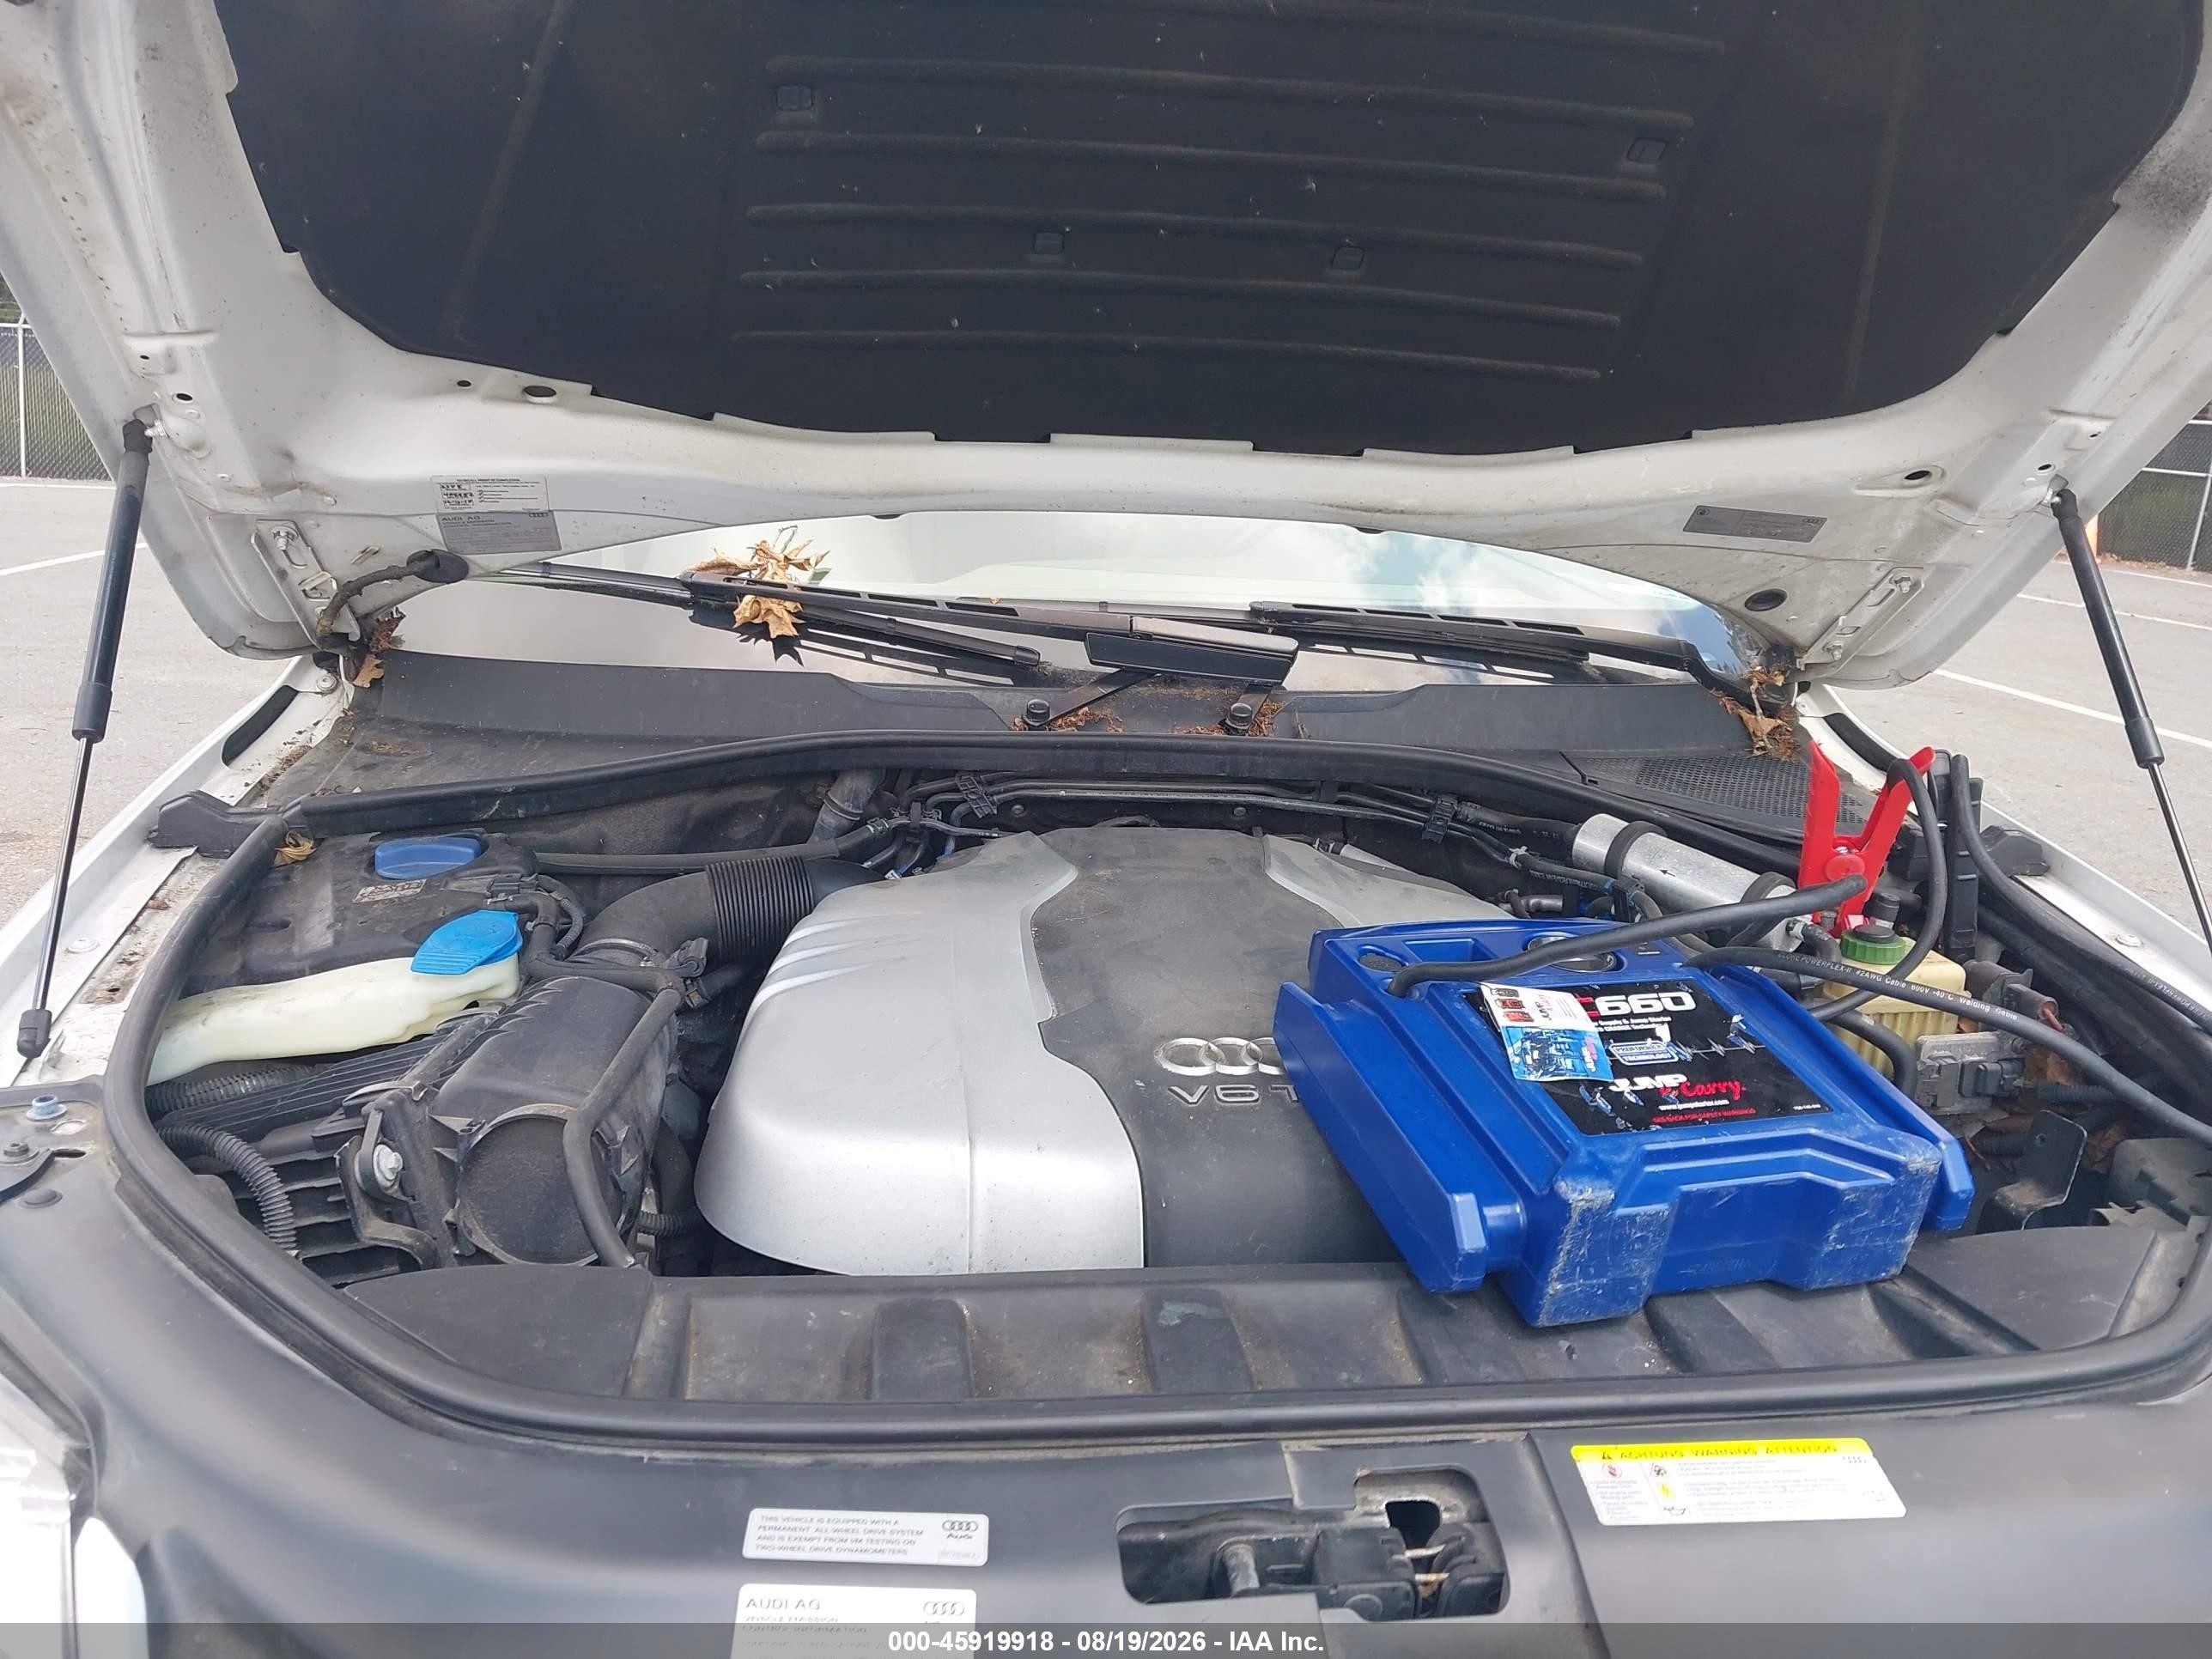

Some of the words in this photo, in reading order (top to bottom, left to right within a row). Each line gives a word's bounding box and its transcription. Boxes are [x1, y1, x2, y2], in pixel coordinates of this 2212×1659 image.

[1856, 969, 1882, 981] #2AWG
[1885, 976, 1906, 988] Cable
[1960, 996, 1990, 1012] Welding
[1168, 1084, 1261, 1107] V6
[1680, 1079, 1741, 1101] Carry
[782, 1516, 814, 1524] VEHICLE
[863, 1527, 887, 1535] DRIVE
[787, 1535, 822, 1544] EXEMPT
[866, 1538, 902, 1547] TESTING
[809, 1545, 833, 1553] DRIVE
[836, 1547, 909, 1557] DYNAMOMETERS
[745, 1598, 788, 1610] AUDI
[794, 1598, 821, 1611] AG
